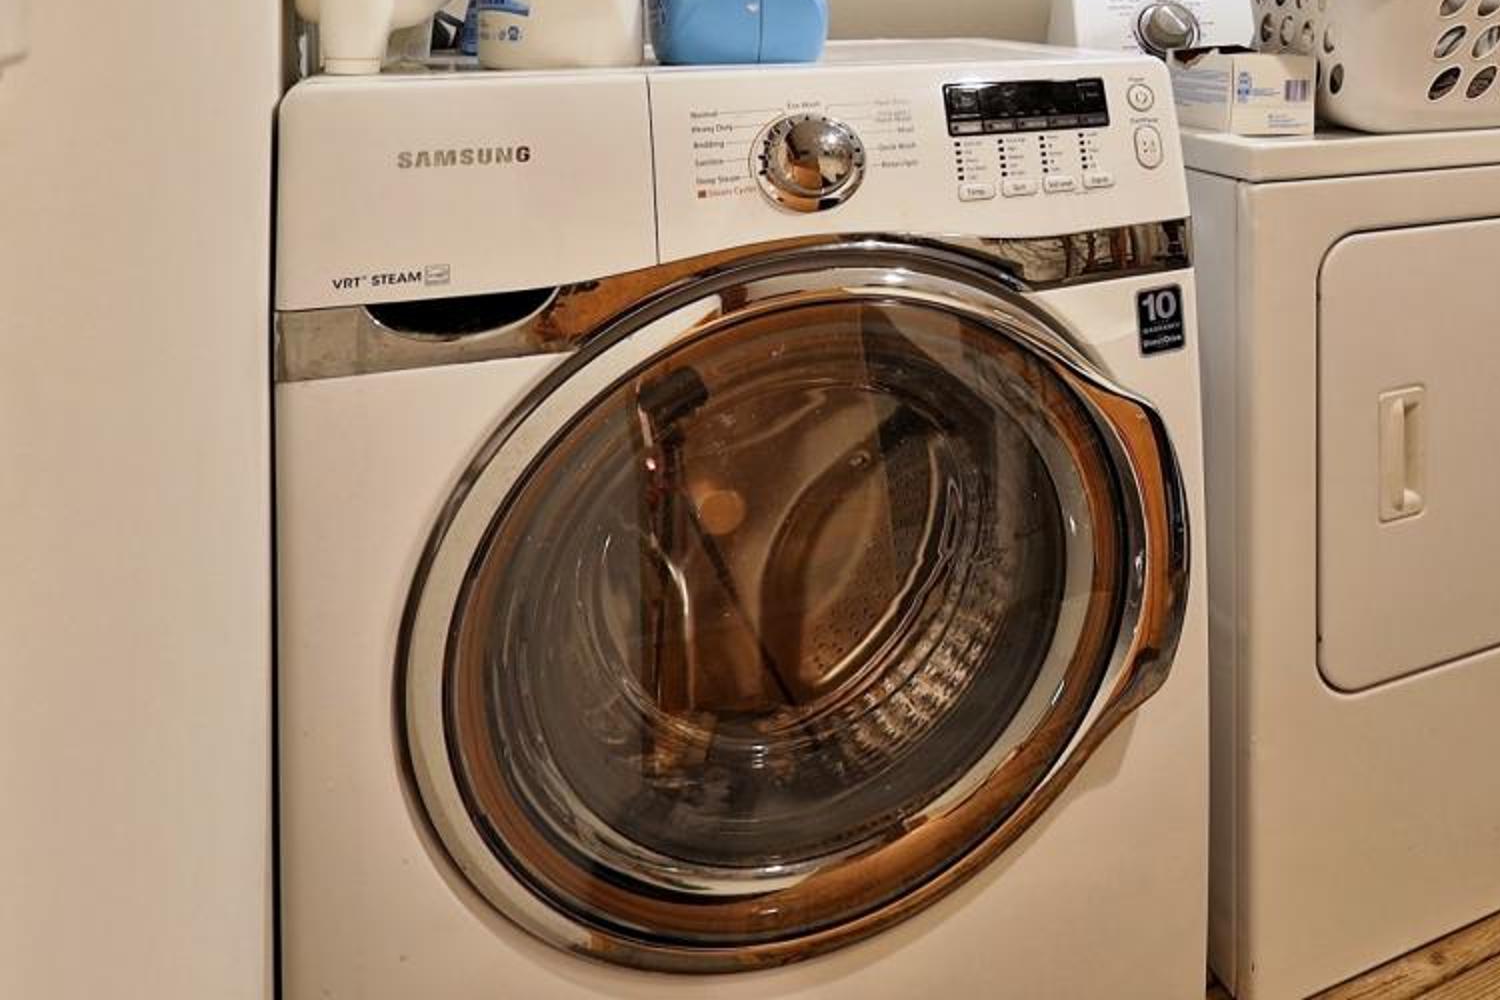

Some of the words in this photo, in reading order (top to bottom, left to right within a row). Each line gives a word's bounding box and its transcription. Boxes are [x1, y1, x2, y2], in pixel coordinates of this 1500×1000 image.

[715, 123, 733, 133] Duty
[396, 145, 531, 169] SAMSUNG
[332, 277, 360, 289] VRT
[371, 271, 422, 287] STEAM
[1141, 291, 1177, 321] 10
